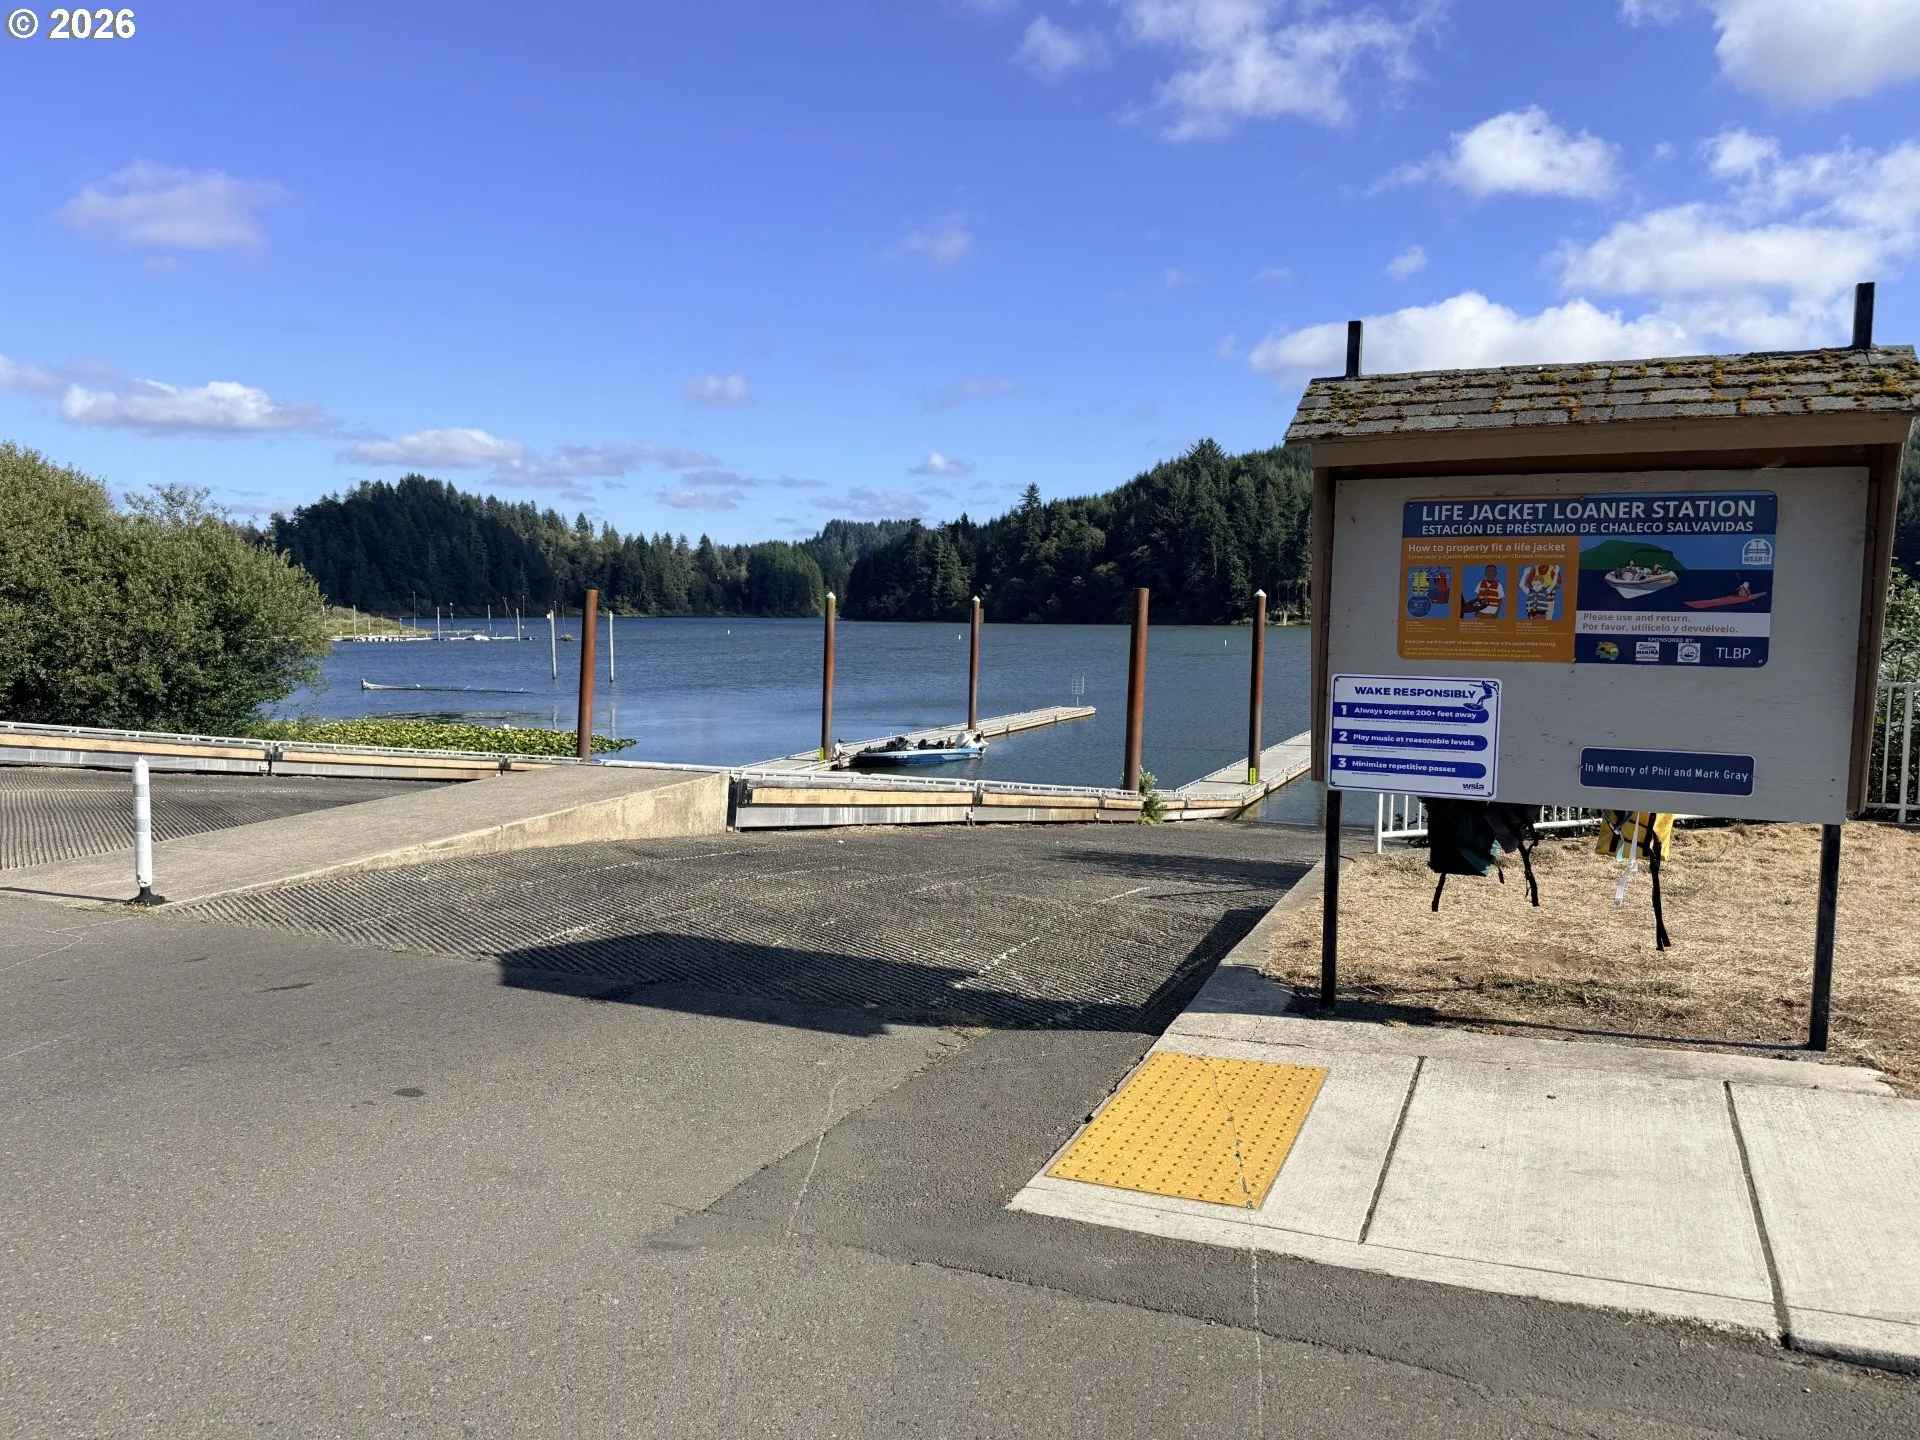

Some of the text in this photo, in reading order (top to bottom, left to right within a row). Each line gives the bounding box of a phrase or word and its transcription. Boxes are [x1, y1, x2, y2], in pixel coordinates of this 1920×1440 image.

[1422, 500, 1756, 521] LIFE JACKET LOANER STATION
[1422, 521, 1754, 536] ESTACIÓN DE PRÉSTAMO DE CHALECO SALVAVIDAS
[1408, 544, 1430, 552] How
[1446, 543, 1488, 554] properly
[1491, 543, 1503, 551] fit
[1514, 542, 1530, 551] life
[1532, 543, 1565, 553] jacket
[1583, 613, 1613, 621] Please
[1635, 614, 1654, 622] and
[1600, 623, 1628, 632] favor,
[1673, 626, 1678, 634] y
[1681, 623, 1738, 633] devuélvelo.
[1716, 646, 1751, 659] TLBP
[1354, 686, 1476, 699] WAKE RESPONSIBLY
[1341, 705, 1347, 715] 1
[1354, 707, 1383, 715] Always
[1384, 708, 1414, 716] operate
[1339, 731, 1347, 741] 2
[1353, 734, 1369, 743] Play
[1405, 736, 1449, 745] reasonable
[1338, 758, 1346, 768] 3
[1352, 760, 1387, 768] Minimize
[1388, 762, 1427, 772] repetitive
[1585, 763, 1748, 782] In Memory of Phil and Mark Gray
